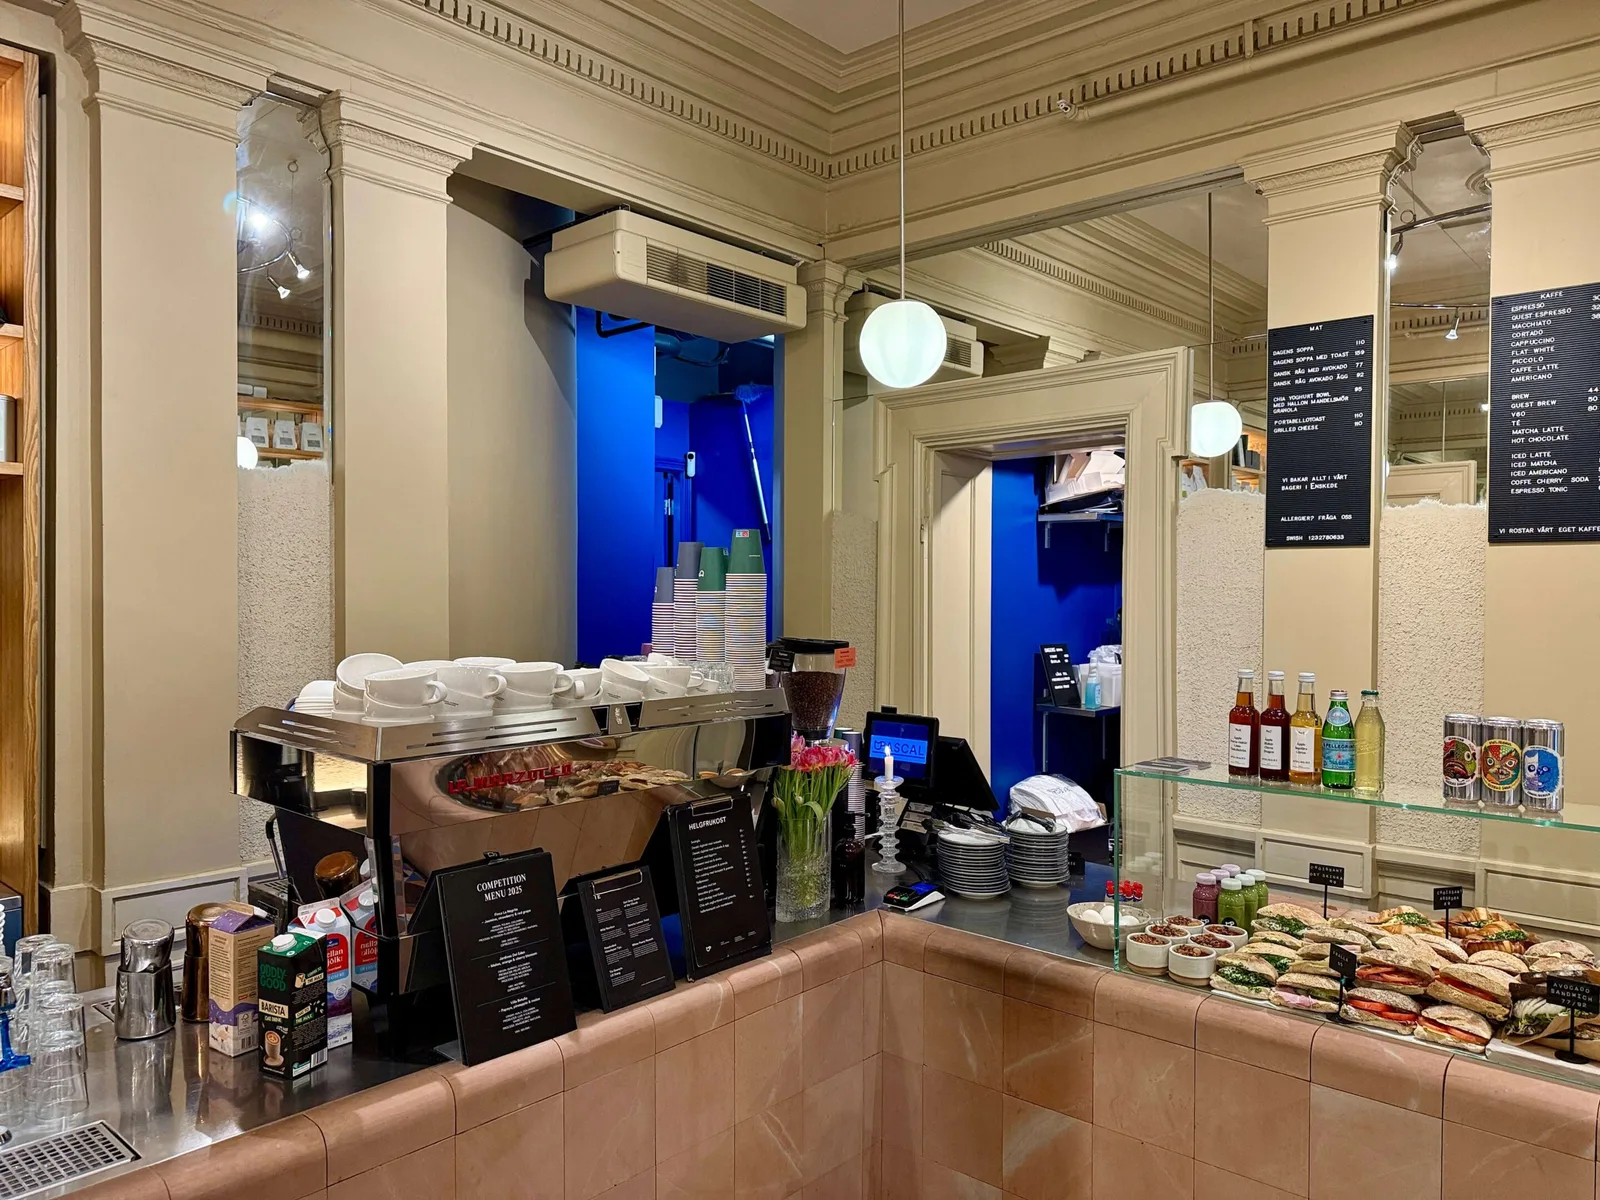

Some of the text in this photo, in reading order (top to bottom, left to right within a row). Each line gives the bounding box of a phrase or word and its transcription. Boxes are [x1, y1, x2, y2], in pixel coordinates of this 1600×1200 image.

[1540, 291, 1563, 299] KAFFE
[1511, 302, 1545, 312] ESPRESSO
[1511, 312, 1533, 320] GUEST
[1535, 307, 1572, 318] ESPRESSO
[1512, 319, 1552, 329] MACCHIATO
[1512, 329, 1543, 338] CORTADO
[1511, 337, 1555, 347] CAPPUCCINO
[1511, 348, 1528, 356] FLAT
[1273, 358, 1294, 366] DAGENS
[1331, 351, 1349, 359] TOAST
[1512, 356, 1544, 365] PICCOLO
[1510, 366, 1532, 374] CAFFE
[1308, 375, 1333, 383] AVOKADO
[1511, 373, 1552, 382] AMERICANO
[1511, 401, 1534, 409] GUEST
[1528, 435, 1569, 443] CHOCOLATE
[1528, 468, 1568, 476] AMERICANO
[688, 816, 726, 830] HELGFRUKOST
[476, 873, 526, 892] COMPETITION
[484, 885, 523, 902] MENU 2025
[260, 975, 286, 991] GOOD
[1553, 982, 1590, 994] AVOCADO
[1550, 988, 1592, 1002] SANDWICH
[261, 1001, 285, 1016] BARISTA
